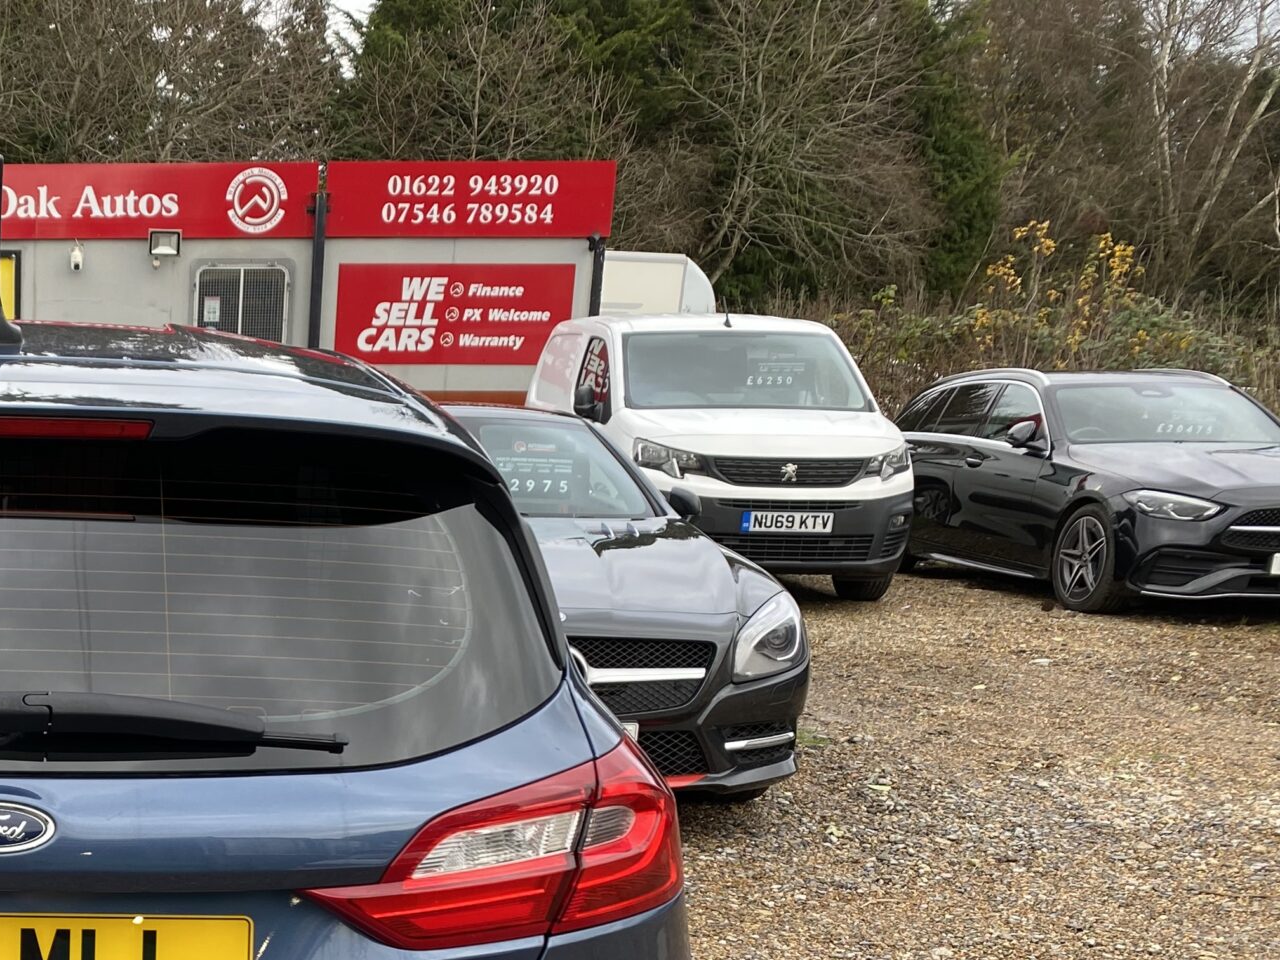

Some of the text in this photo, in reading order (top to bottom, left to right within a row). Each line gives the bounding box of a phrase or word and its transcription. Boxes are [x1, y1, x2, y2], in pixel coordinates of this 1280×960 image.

[387, 174, 559, 196] 01622 943920
[72, 185, 179, 218] Autos
[381, 202, 554, 224] 07546 789584
[401, 277, 448, 301] WE
[468, 283, 524, 298] Finance
[372, 301, 439, 326] SELL
[462, 308, 551, 321] PX Welcome
[357, 327, 436, 352] CARS
[459, 334, 525, 351] Warranty
[746, 375, 793, 386] £6250
[753, 514, 831, 530] NU69 KTV
